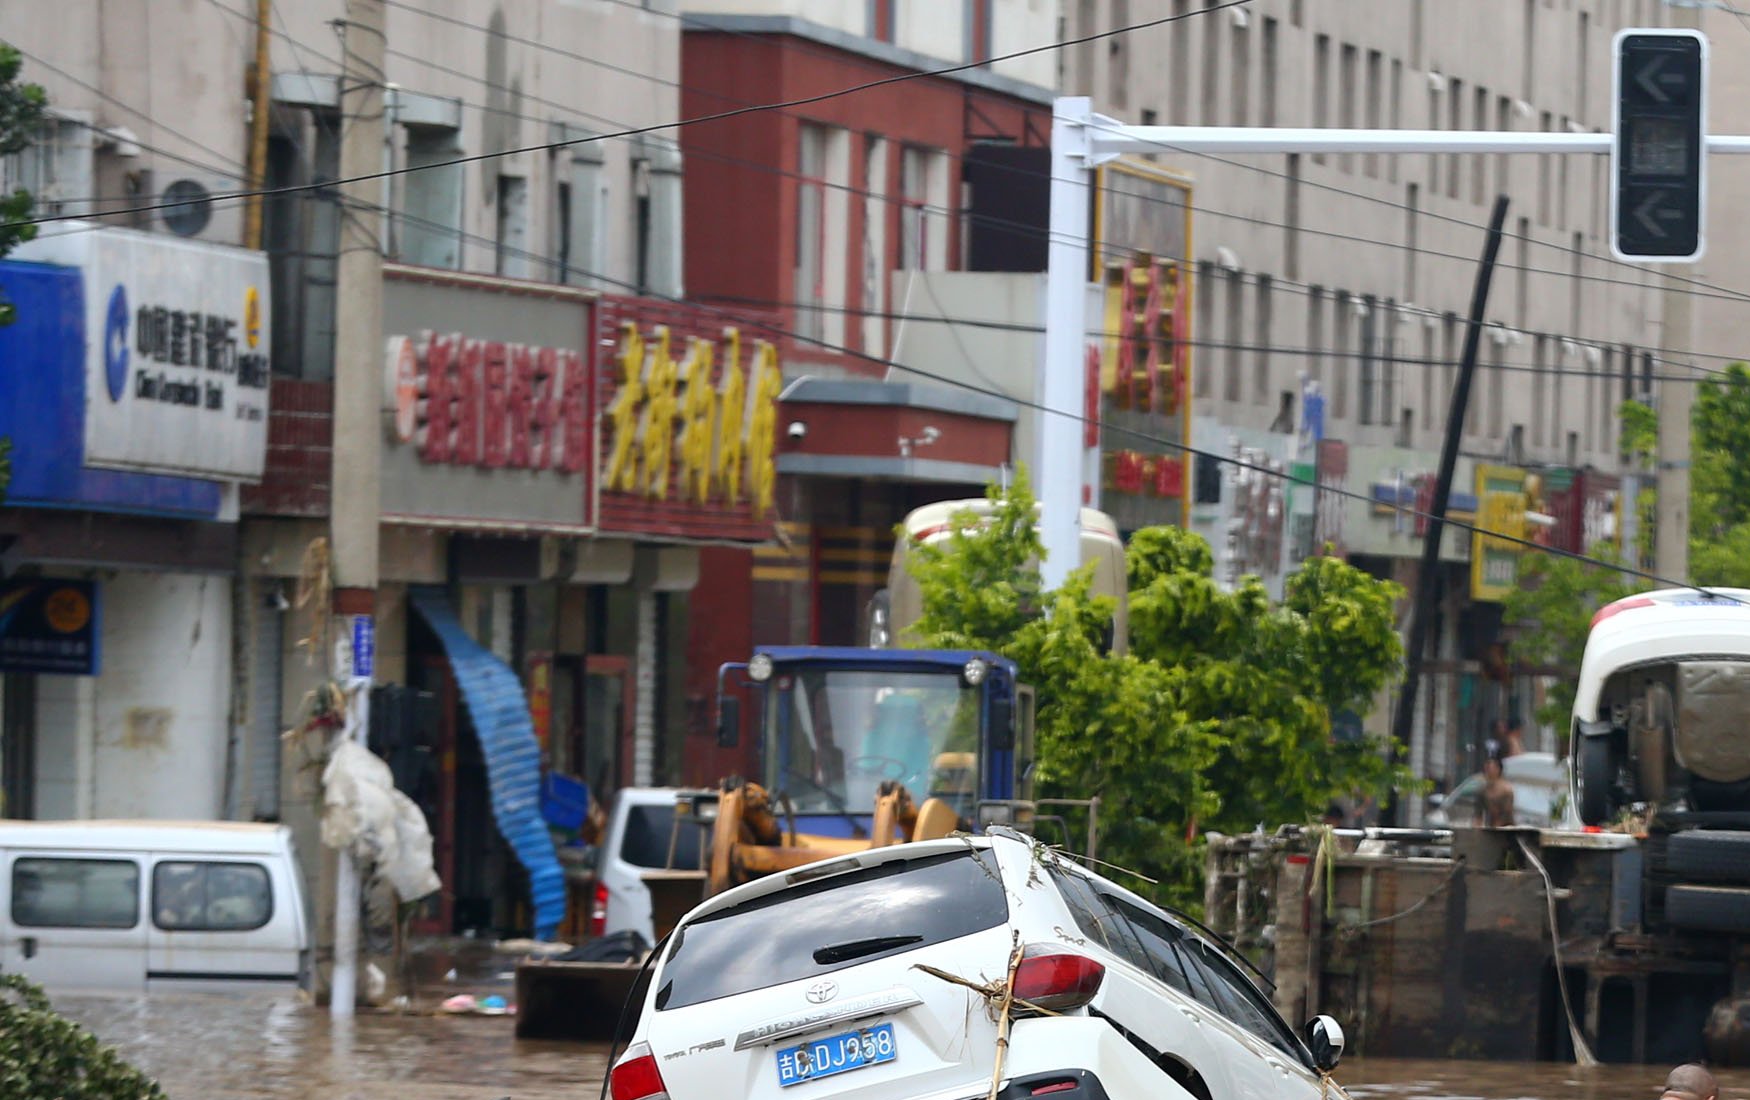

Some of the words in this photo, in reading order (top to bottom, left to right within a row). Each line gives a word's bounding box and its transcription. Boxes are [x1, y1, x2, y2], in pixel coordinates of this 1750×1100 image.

[136, 303, 238, 375] 中国建设银行
